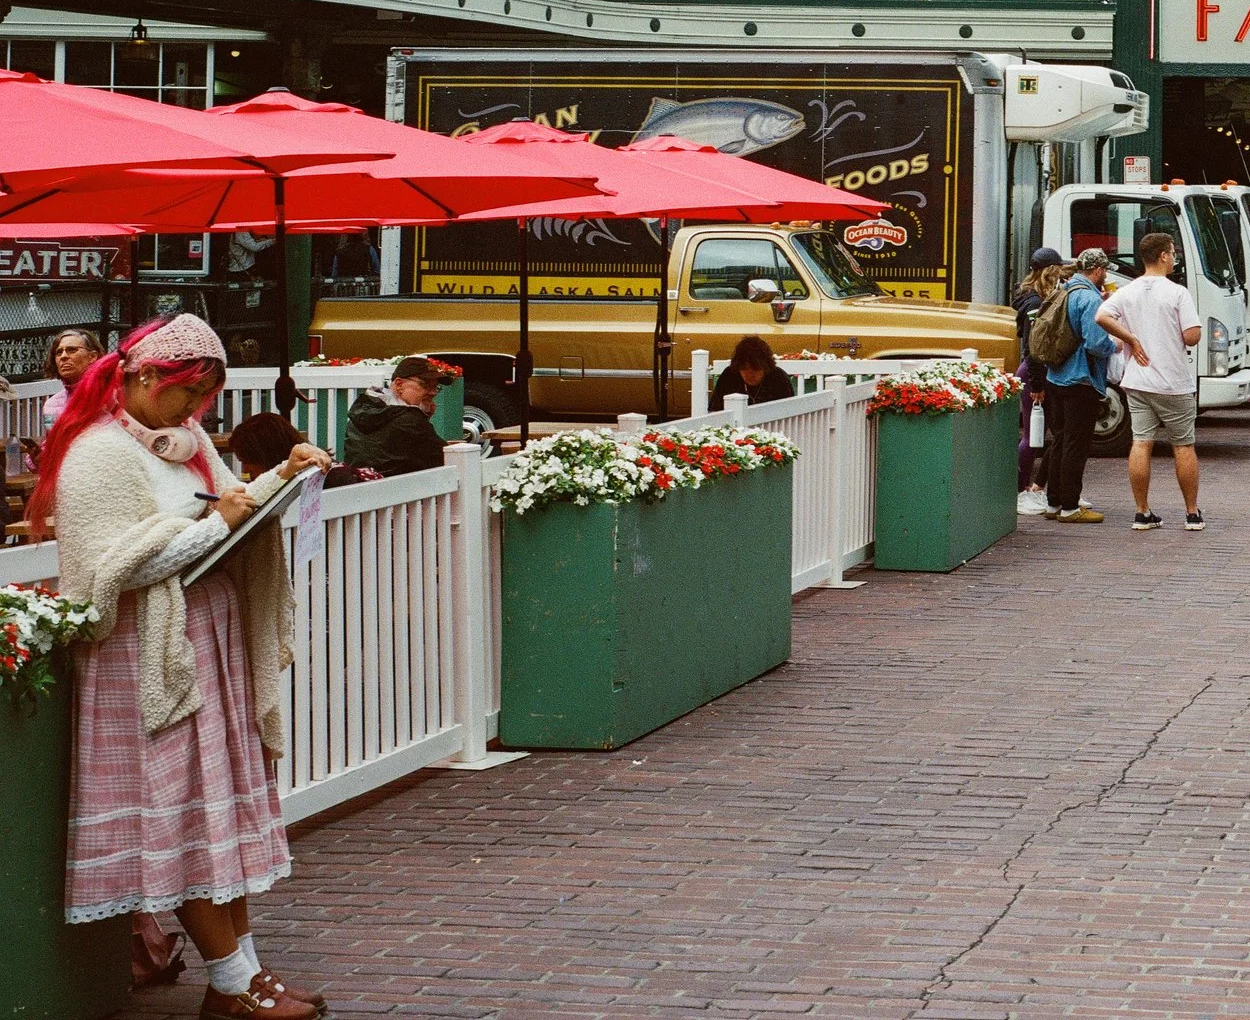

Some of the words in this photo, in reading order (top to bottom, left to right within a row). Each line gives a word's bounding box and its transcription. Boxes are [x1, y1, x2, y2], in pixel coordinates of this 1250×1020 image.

[848, 227, 874, 240] OCEAN
[874, 226, 903, 240] BEAUTY
[853, 250, 871, 259] SINCE
[507, 284, 594, 296] AASKA
